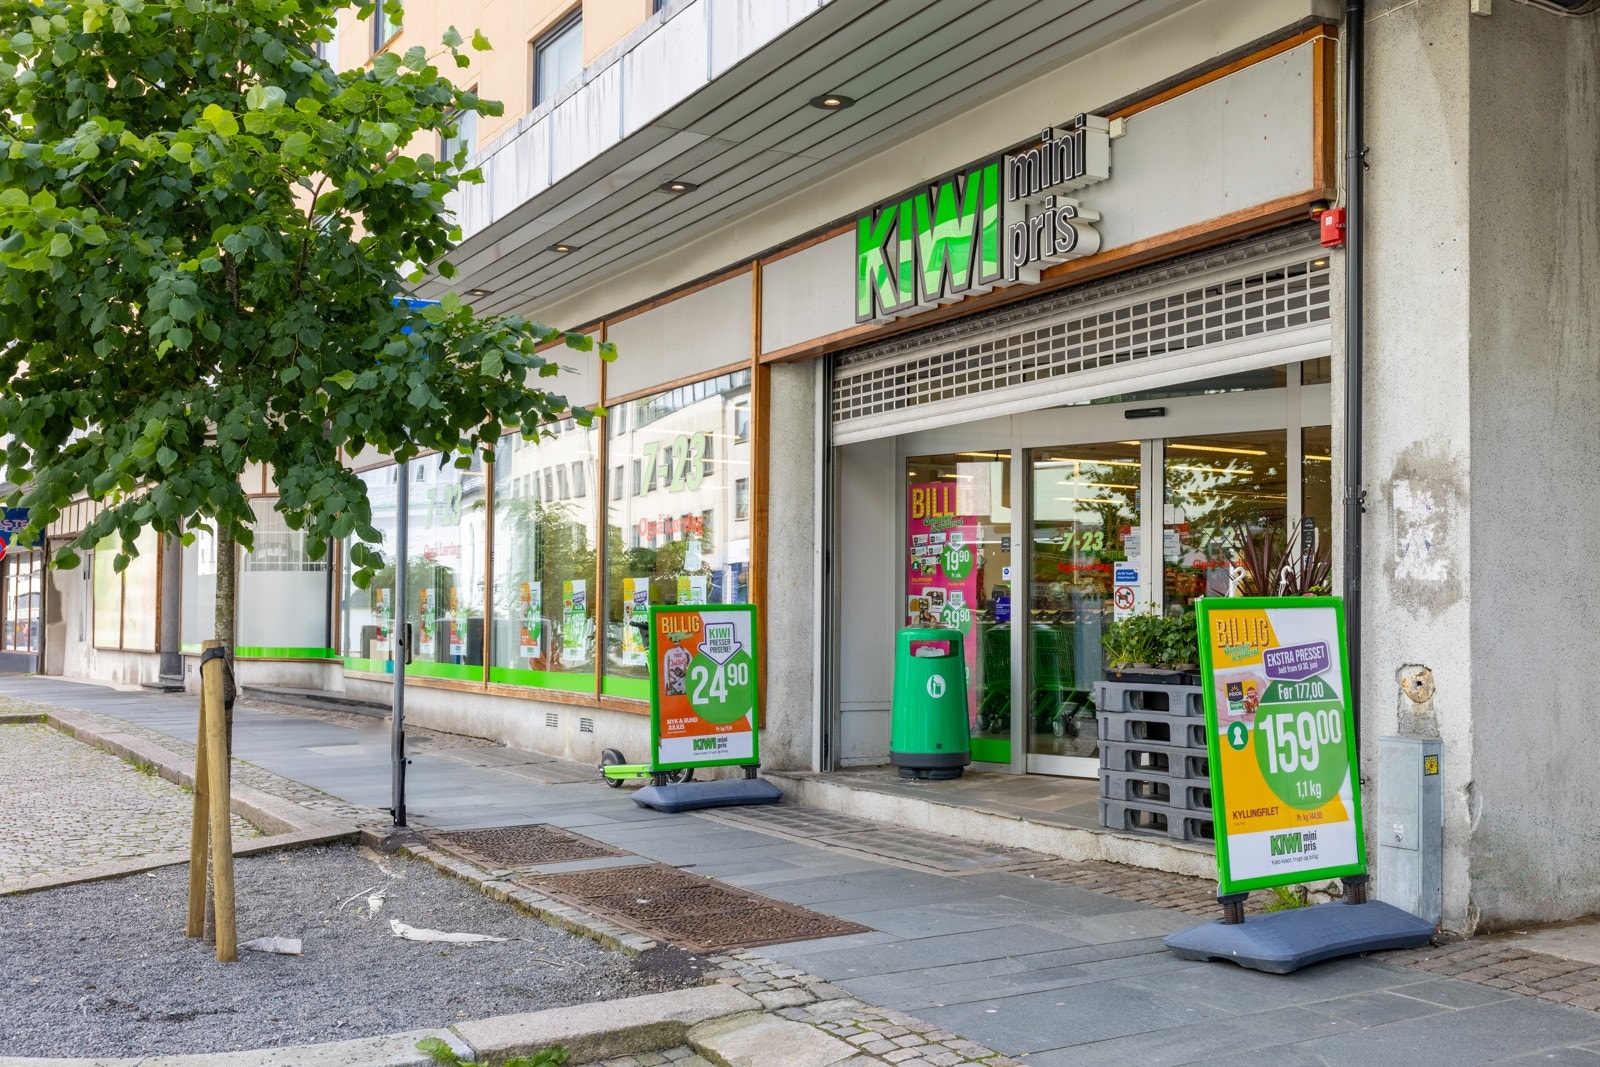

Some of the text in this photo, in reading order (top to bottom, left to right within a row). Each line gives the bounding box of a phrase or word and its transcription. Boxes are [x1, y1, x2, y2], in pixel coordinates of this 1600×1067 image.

[1007, 113, 1086, 202] mini
[855, 158, 1003, 323] KIWI
[1007, 195, 1078, 282] pris
[640, 431, 706, 497] 7-23
[1061, 531, 1104, 551] 7-23
[661, 616, 699, 633] BILLIG
[709, 628, 731, 639] KIWI
[1216, 618, 1270, 648] BILLIG
[1267, 646, 1325, 667] EKSTRA PRESSET
[1278, 682, 1324, 700] Før 177,00
[693, 737, 716, 751] KIWI
[1296, 780, 1321, 800] 1,1 kg
[1233, 807, 1279, 820] KYLLINGFILET
[1270, 832, 1303, 856] KIWI
[1303, 830, 1317, 841] mini
[1303, 841, 1317, 854] pris
